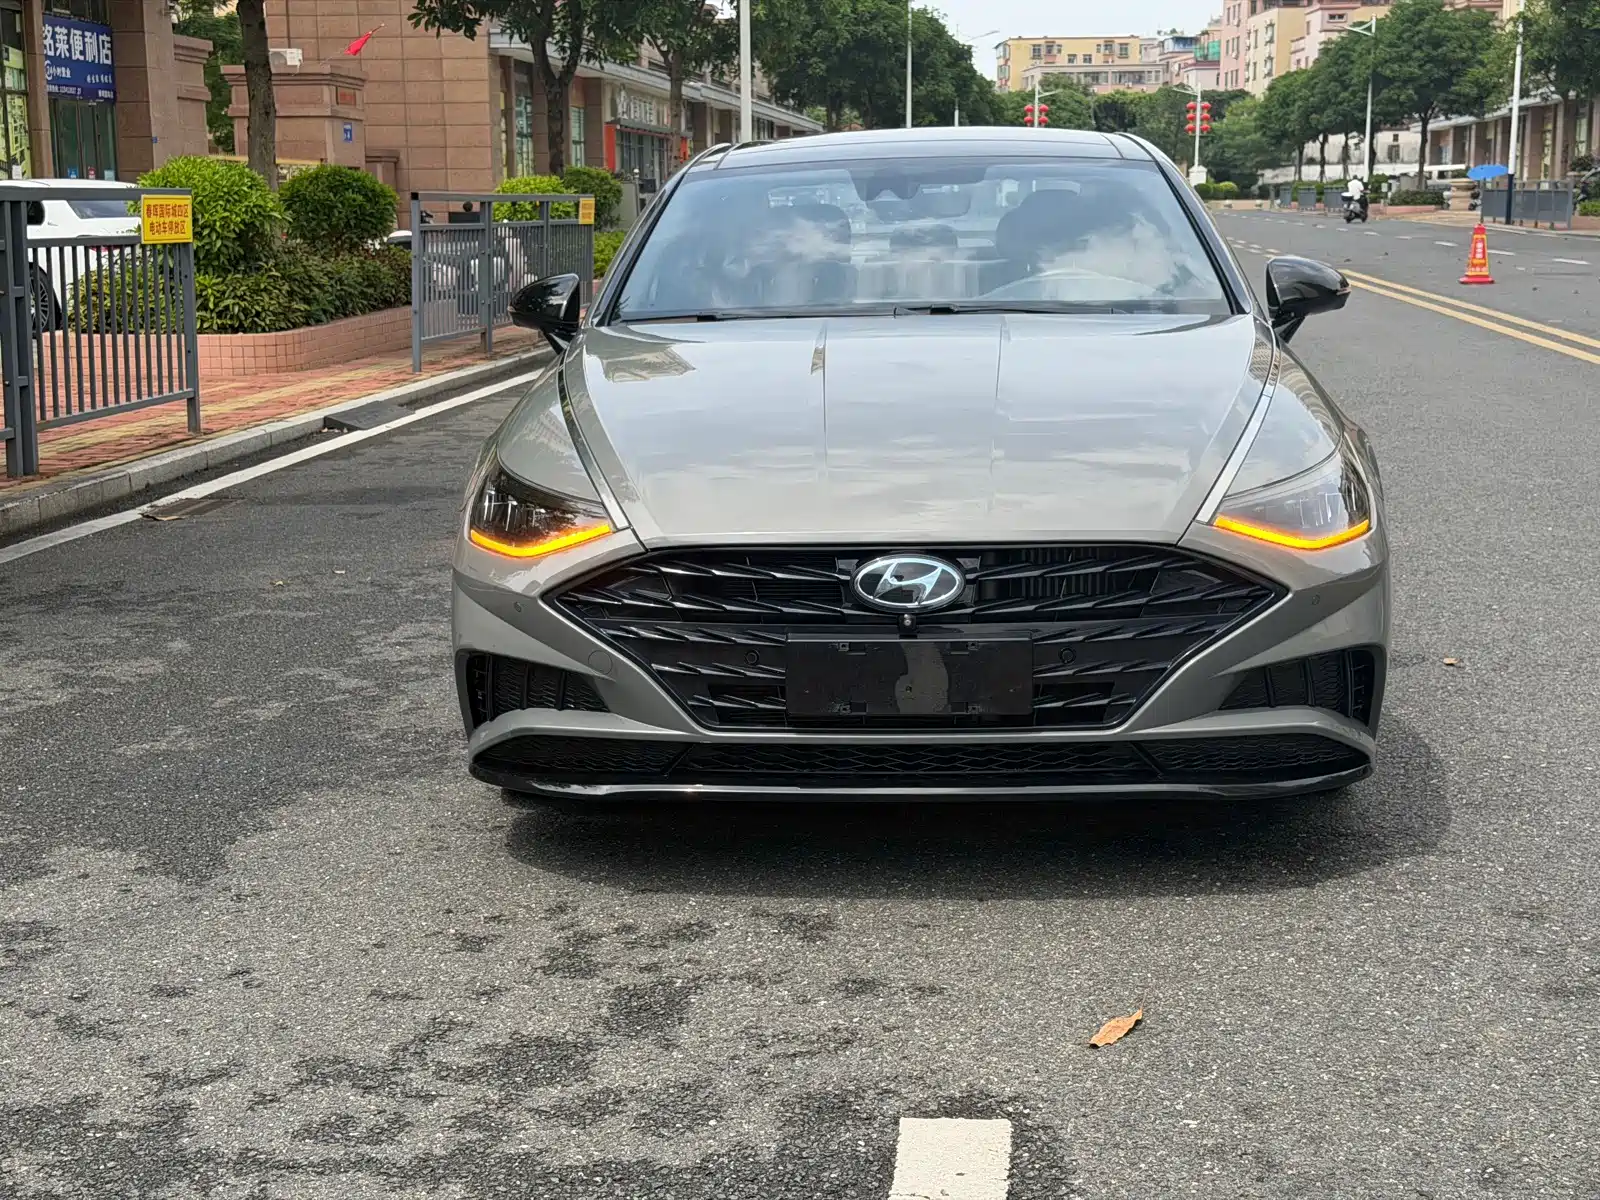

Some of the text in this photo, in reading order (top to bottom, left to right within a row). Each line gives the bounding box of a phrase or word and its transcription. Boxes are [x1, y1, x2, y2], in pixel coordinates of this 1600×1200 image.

[149, 220, 186, 235] 电动车停放区
